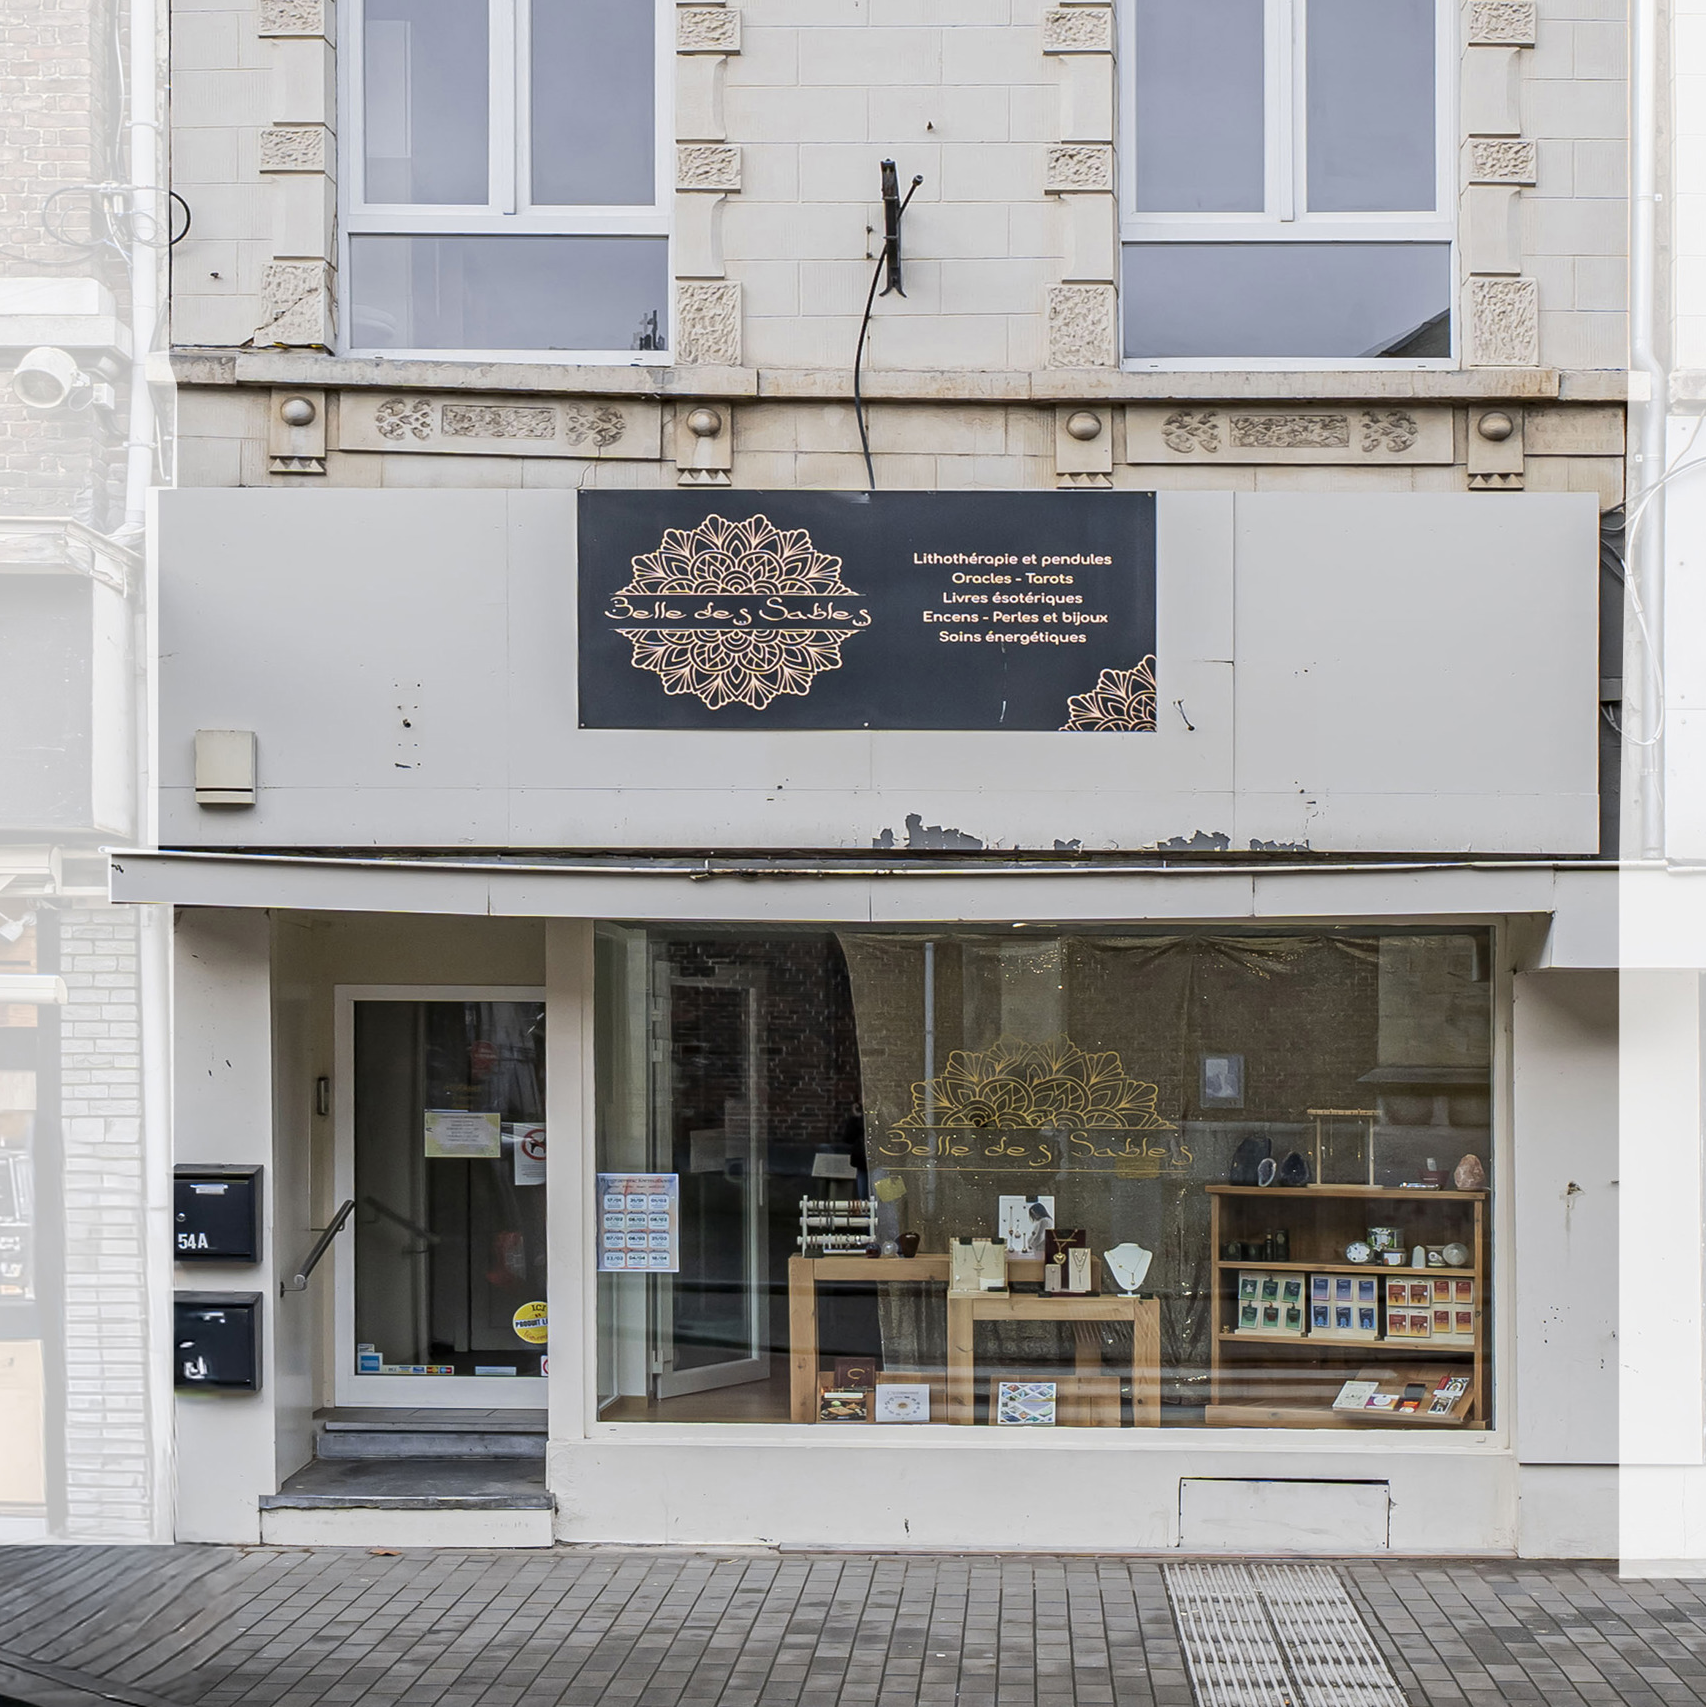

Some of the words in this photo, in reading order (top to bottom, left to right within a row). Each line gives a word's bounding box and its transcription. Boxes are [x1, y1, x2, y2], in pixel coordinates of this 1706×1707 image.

[913, 551, 1019, 567] Lithothérapie
[1022, 553, 1037, 566] et
[1040, 551, 1112, 568] pendules
[951, 572, 1012, 585] Oracles
[1025, 572, 1074, 585] Tarots
[942, 591, 988, 604] Livres
[991, 591, 1083, 607] ésotériques
[604, 595, 687, 621] Belle
[694, 600, 753, 627] des
[765, 596, 872, 627] Sables
[922, 610, 980, 624] Encens
[992, 610, 1041, 624] Perles
[1044, 612, 1058, 624] et
[1062, 610, 1108, 626] bijoux
[938, 630, 982, 644] Soins
[985, 630, 1087, 645] énergétiques
[878, 1129, 976, 1158] Belle
[985, 1136, 1052, 1166] des
[1071, 1130, 1194, 1166] Sables
[178, 1233, 209, 1249] 54A
